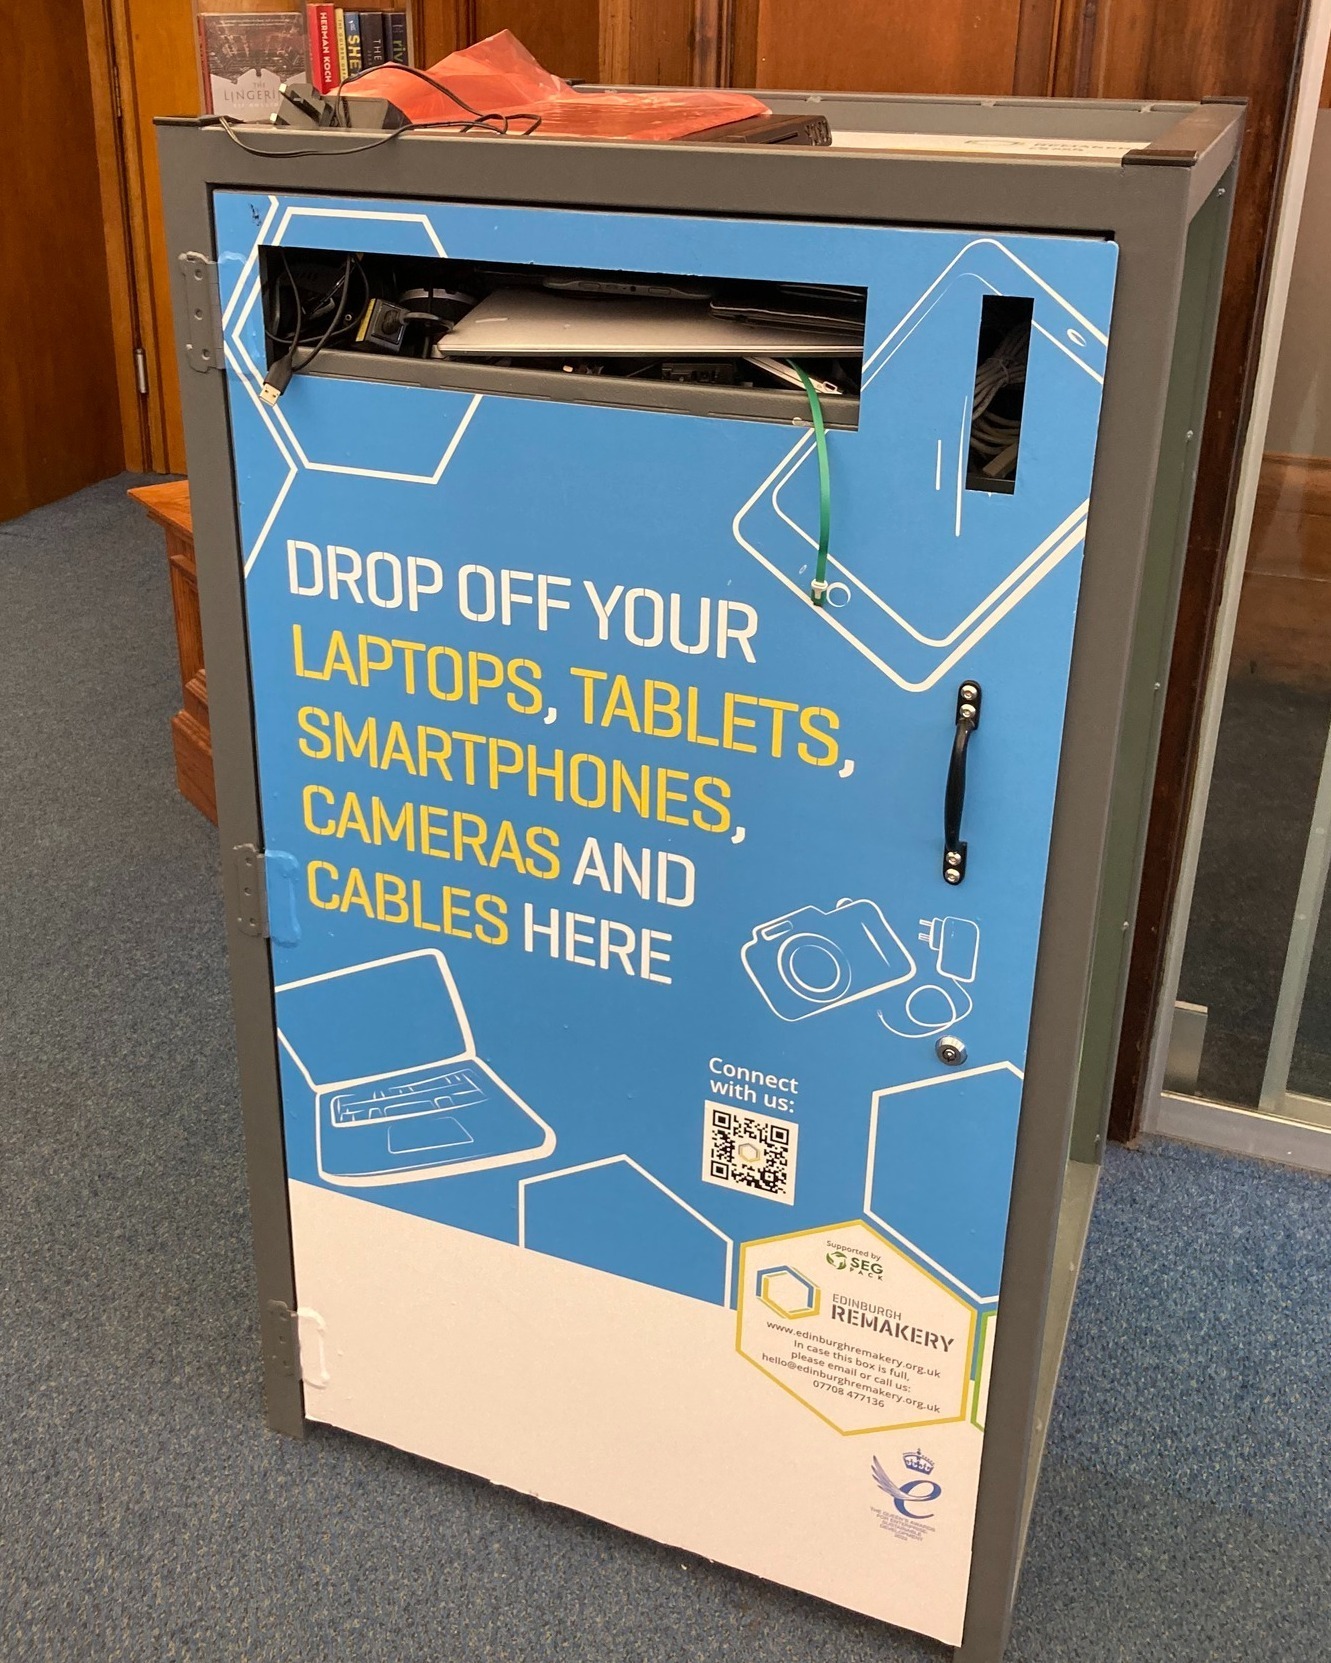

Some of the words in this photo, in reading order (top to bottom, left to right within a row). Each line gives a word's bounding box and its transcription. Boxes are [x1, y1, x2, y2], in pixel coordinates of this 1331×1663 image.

[320, 12, 330, 53] HERMAN
[373, 39, 383, 60] THE
[253, 81, 266, 89] THE
[323, 56, 333, 83] KOCH
[286, 539, 444, 612] DROP
[458, 564, 572, 631] OFF
[583, 580, 759, 664] YOUR
[292, 623, 557, 725] LAPTOPS,
[570, 667, 855, 778] TABLETS,
[297, 706, 746, 844] SMARTPHONES,
[302, 784, 561, 881] CAMERAS
[572, 836, 696, 908] AND
[306, 860, 509, 946] CABLES
[524, 903, 673, 985] HERE
[709, 1057, 799, 1094] Connect
[710, 1079, 757, 1104] with
[764, 1093, 795, 1114] us:
[826, 1240, 869, 1258] Supported
[871, 1252, 882, 1262] by
[850, 1257, 884, 1275] SEG
[849, 1266, 884, 1282] PACK
[832, 1293, 902, 1321] EDINBURGH
[831, 1304, 955, 1352] REMAKERY
[766, 1321, 941, 1378] www.edinburghremakery.org.uk
[794, 1340, 804, 1350] In
[806, 1345, 830, 1357] case
[833, 1352, 853, 1364] this
[855, 1357, 875, 1371] box
[878, 1364, 887, 1374] is
[889, 1367, 910, 1382] full,
[762, 1352, 941, 1414] hello@edinburghremakery.org.uk
[791, 1352, 825, 1367] please
[827, 1362, 857, 1377] email
[859, 1372, 872, 1380] or
[874, 1376, 893, 1388] call
[895, 1383, 911, 1393] us:
[813, 1380, 844, 1396] 07708
[846, 1390, 885, 1408] 477136
